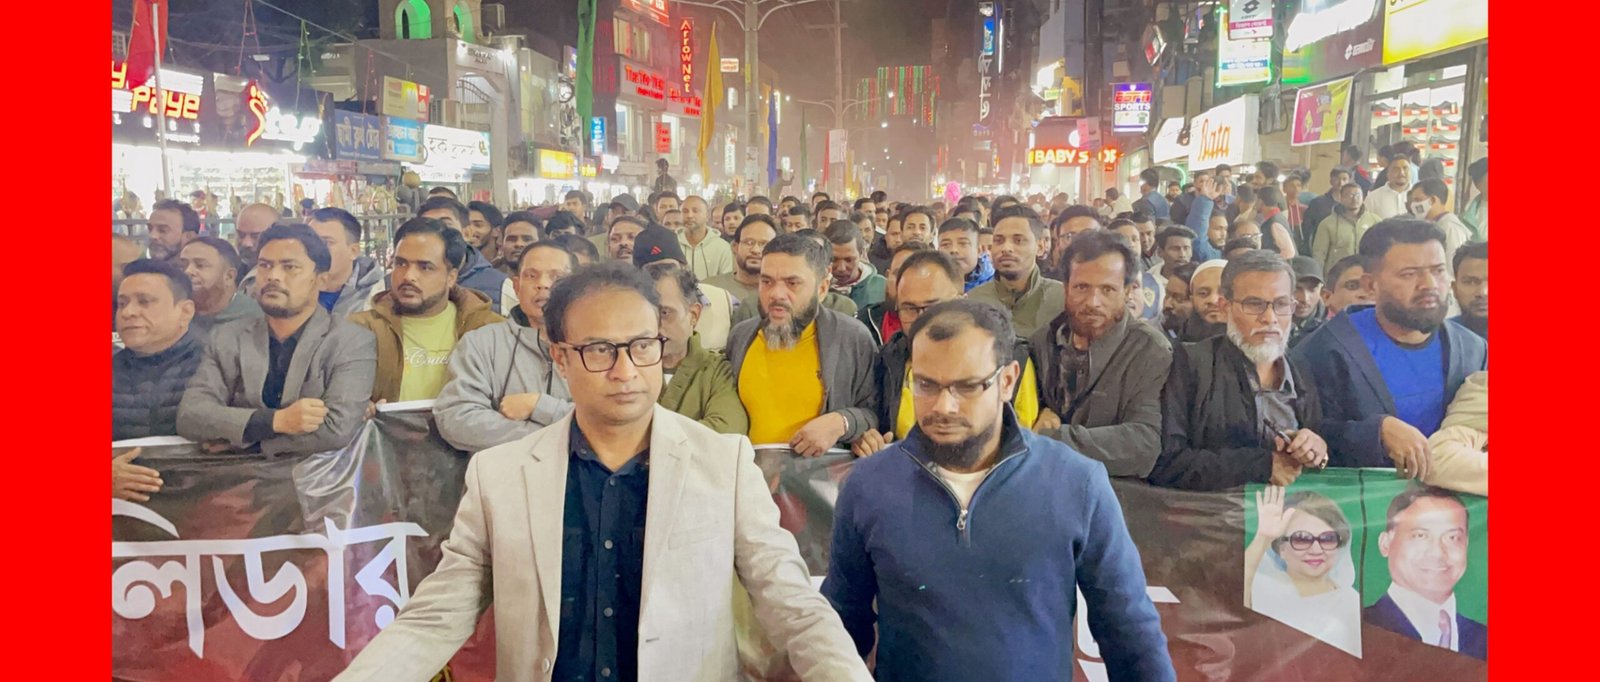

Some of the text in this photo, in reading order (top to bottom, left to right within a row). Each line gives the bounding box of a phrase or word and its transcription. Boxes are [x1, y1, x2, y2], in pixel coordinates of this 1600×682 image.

[682, 63, 692, 93] Net
[1114, 90, 1152, 103] ESPN
[1113, 103, 1151, 111] SPORTS
[1198, 118, 1231, 161] Bata
[1034, 149, 1117, 163] BABY SOP
